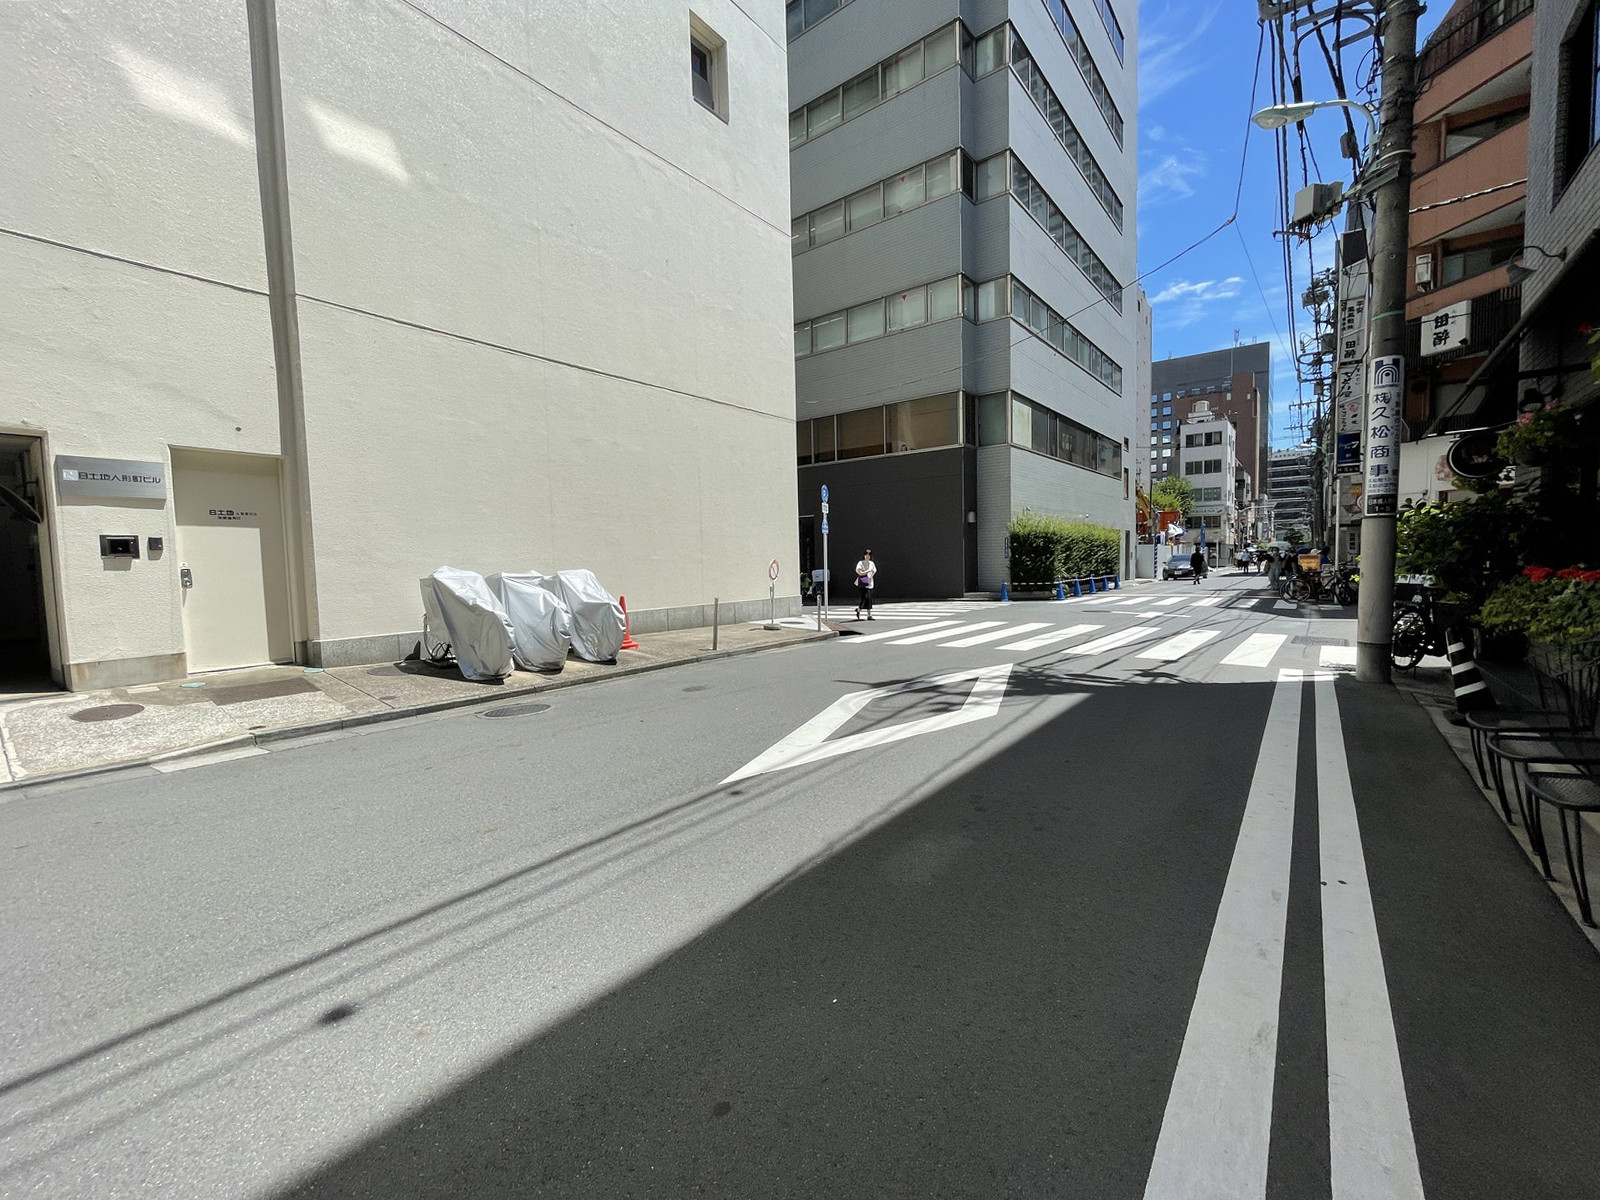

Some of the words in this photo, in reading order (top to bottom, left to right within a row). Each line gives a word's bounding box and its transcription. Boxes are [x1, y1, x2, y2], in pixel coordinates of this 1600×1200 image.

[78, 472, 161, 484] 日土地人形町ビル
